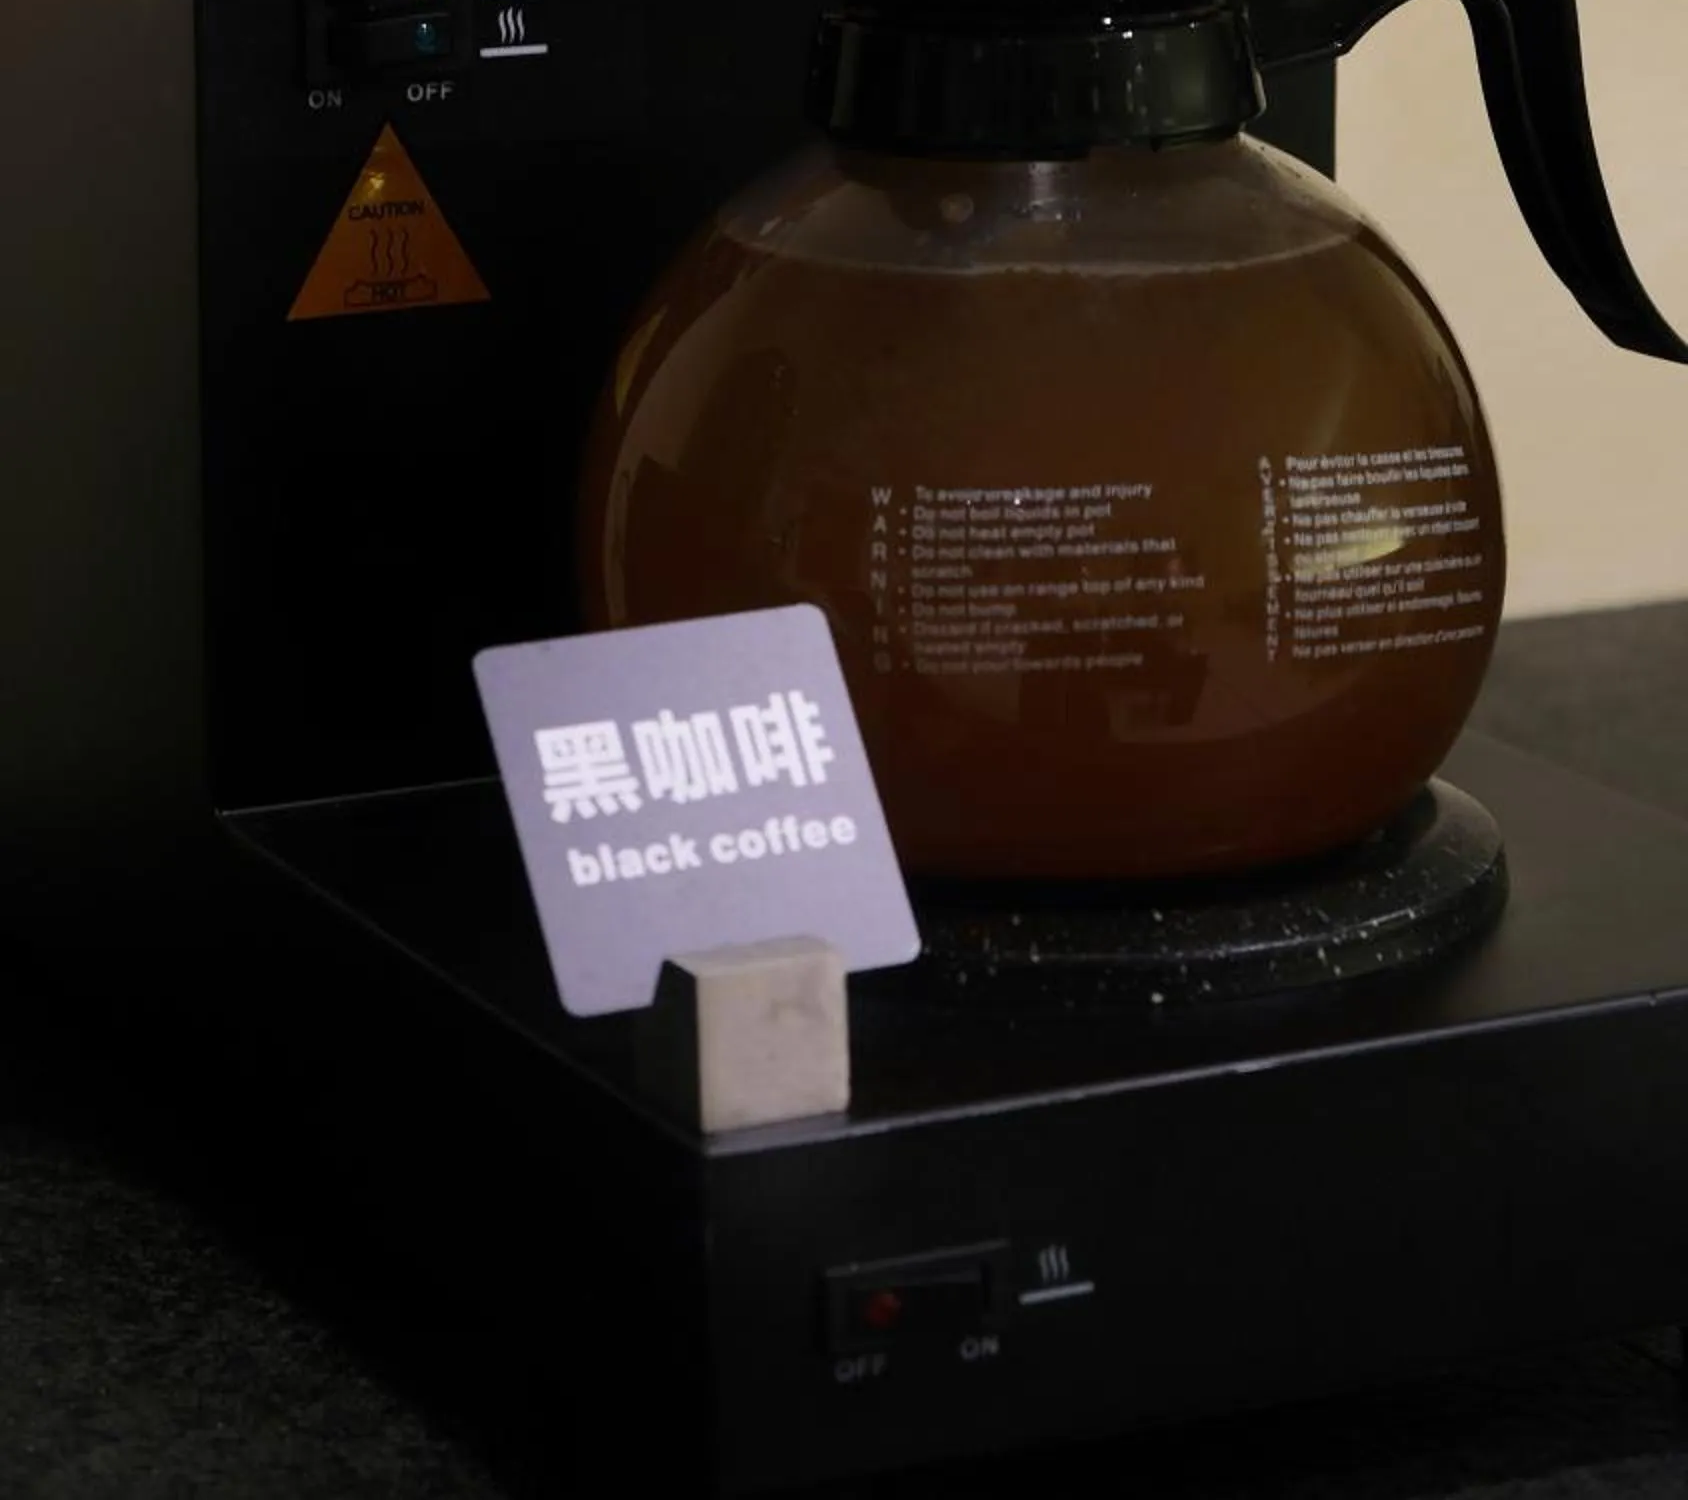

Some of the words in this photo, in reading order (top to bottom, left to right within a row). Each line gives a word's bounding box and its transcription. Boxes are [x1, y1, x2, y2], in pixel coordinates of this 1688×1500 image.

[308, 88, 343, 110] ON
[406, 80, 457, 103] OFF
[348, 200, 426, 221] CAUTION
[915, 484, 934, 501] To
[1068, 483, 1102, 499] and
[1105, 482, 1153, 501] injury
[913, 504, 936, 520] Do
[939, 505, 967, 519] not
[1063, 503, 1080, 517] in
[1084, 501, 1112, 520] pot
[912, 524, 936, 540] Do
[939, 525, 966, 540] not
[969, 524, 1006, 540] heat
[1010, 522, 1063, 543] empty
[1067, 521, 1095, 540] pot
[912, 544, 935, 560] Do
[938, 544, 966, 559] not
[1142, 536, 1177, 552] that
[911, 583, 935, 599] Do
[938, 584, 965, 598] not
[1028, 582, 1079, 599] range
[1082, 578, 1111, 596] top
[1113, 576, 1132, 592] of
[1134, 577, 1167, 594] any
[1169, 575, 1205, 591] kind
[911, 602, 935, 618] Do
[534, 689, 836, 824] 黑咖啡
[566, 833, 702, 887] black
[708, 814, 858, 864] coffee
[959, 1334, 1000, 1362] ON
